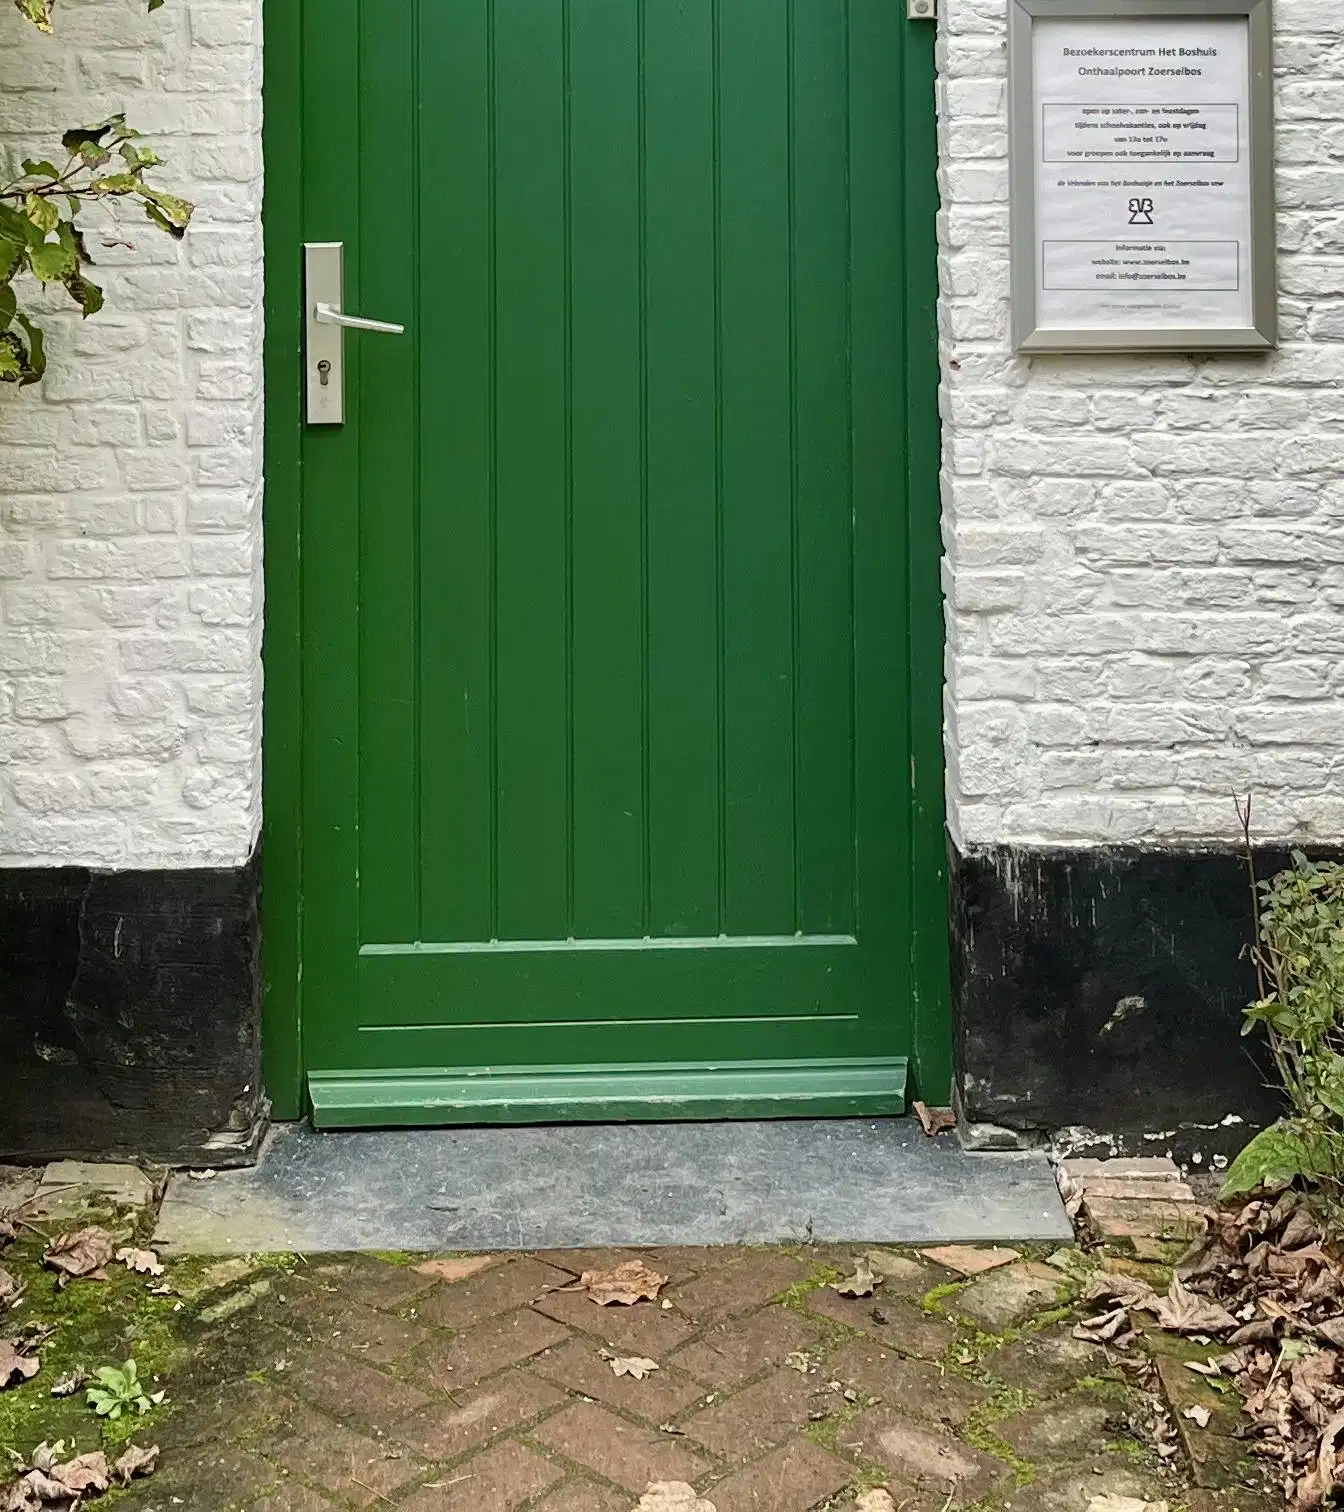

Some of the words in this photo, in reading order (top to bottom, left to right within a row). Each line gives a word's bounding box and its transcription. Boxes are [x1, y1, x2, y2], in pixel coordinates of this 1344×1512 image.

[1062, 47, 1156, 57] Bezoekerscentrum
[1158, 47, 1176, 57] Het
[1178, 47, 1217, 57] Boshuis
[1078, 66, 1145, 78] Onthaalpoort
[1148, 66, 1202, 76] Zoerselbos
[1084, 150, 1113, 158] groepen
[1129, 149, 1171, 158] toegankelijk
